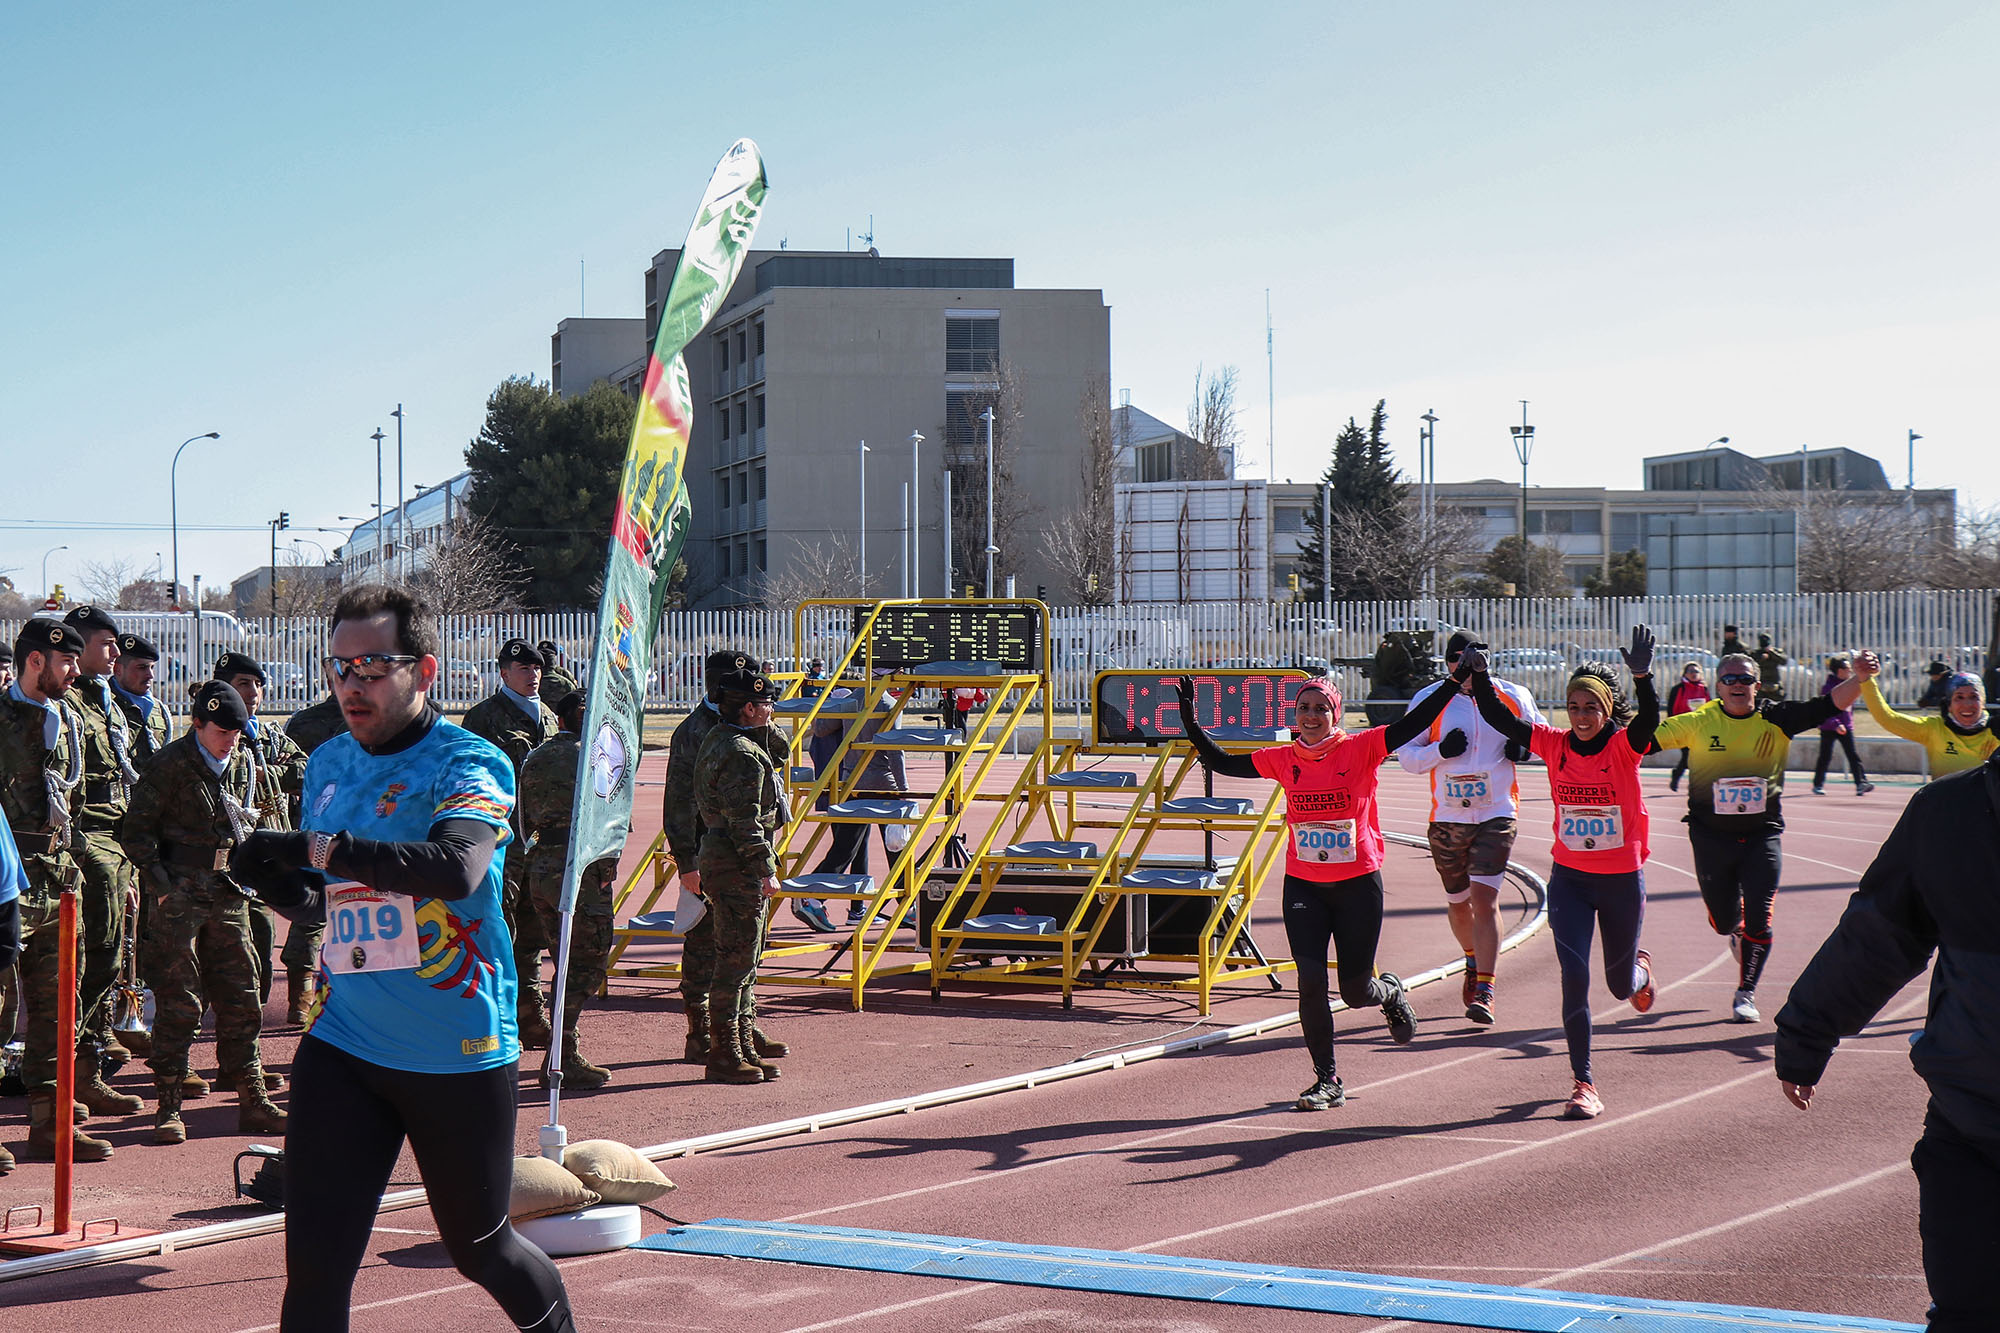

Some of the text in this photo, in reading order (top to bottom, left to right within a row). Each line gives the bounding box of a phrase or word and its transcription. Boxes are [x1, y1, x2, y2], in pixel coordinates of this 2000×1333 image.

[1446, 781, 1487, 798] 1123
[1557, 785, 1599, 797] CORRER
[1718, 787, 1763, 803] 1793
[1291, 793, 1336, 804] CORRER
[1293, 801, 1347, 812] VALIENTES
[1558, 794, 1611, 804] VALIENTES
[1564, 818, 1617, 837] 2001
[1297, 830, 1351, 849] 2000
[331, 904, 403, 945] 1019
